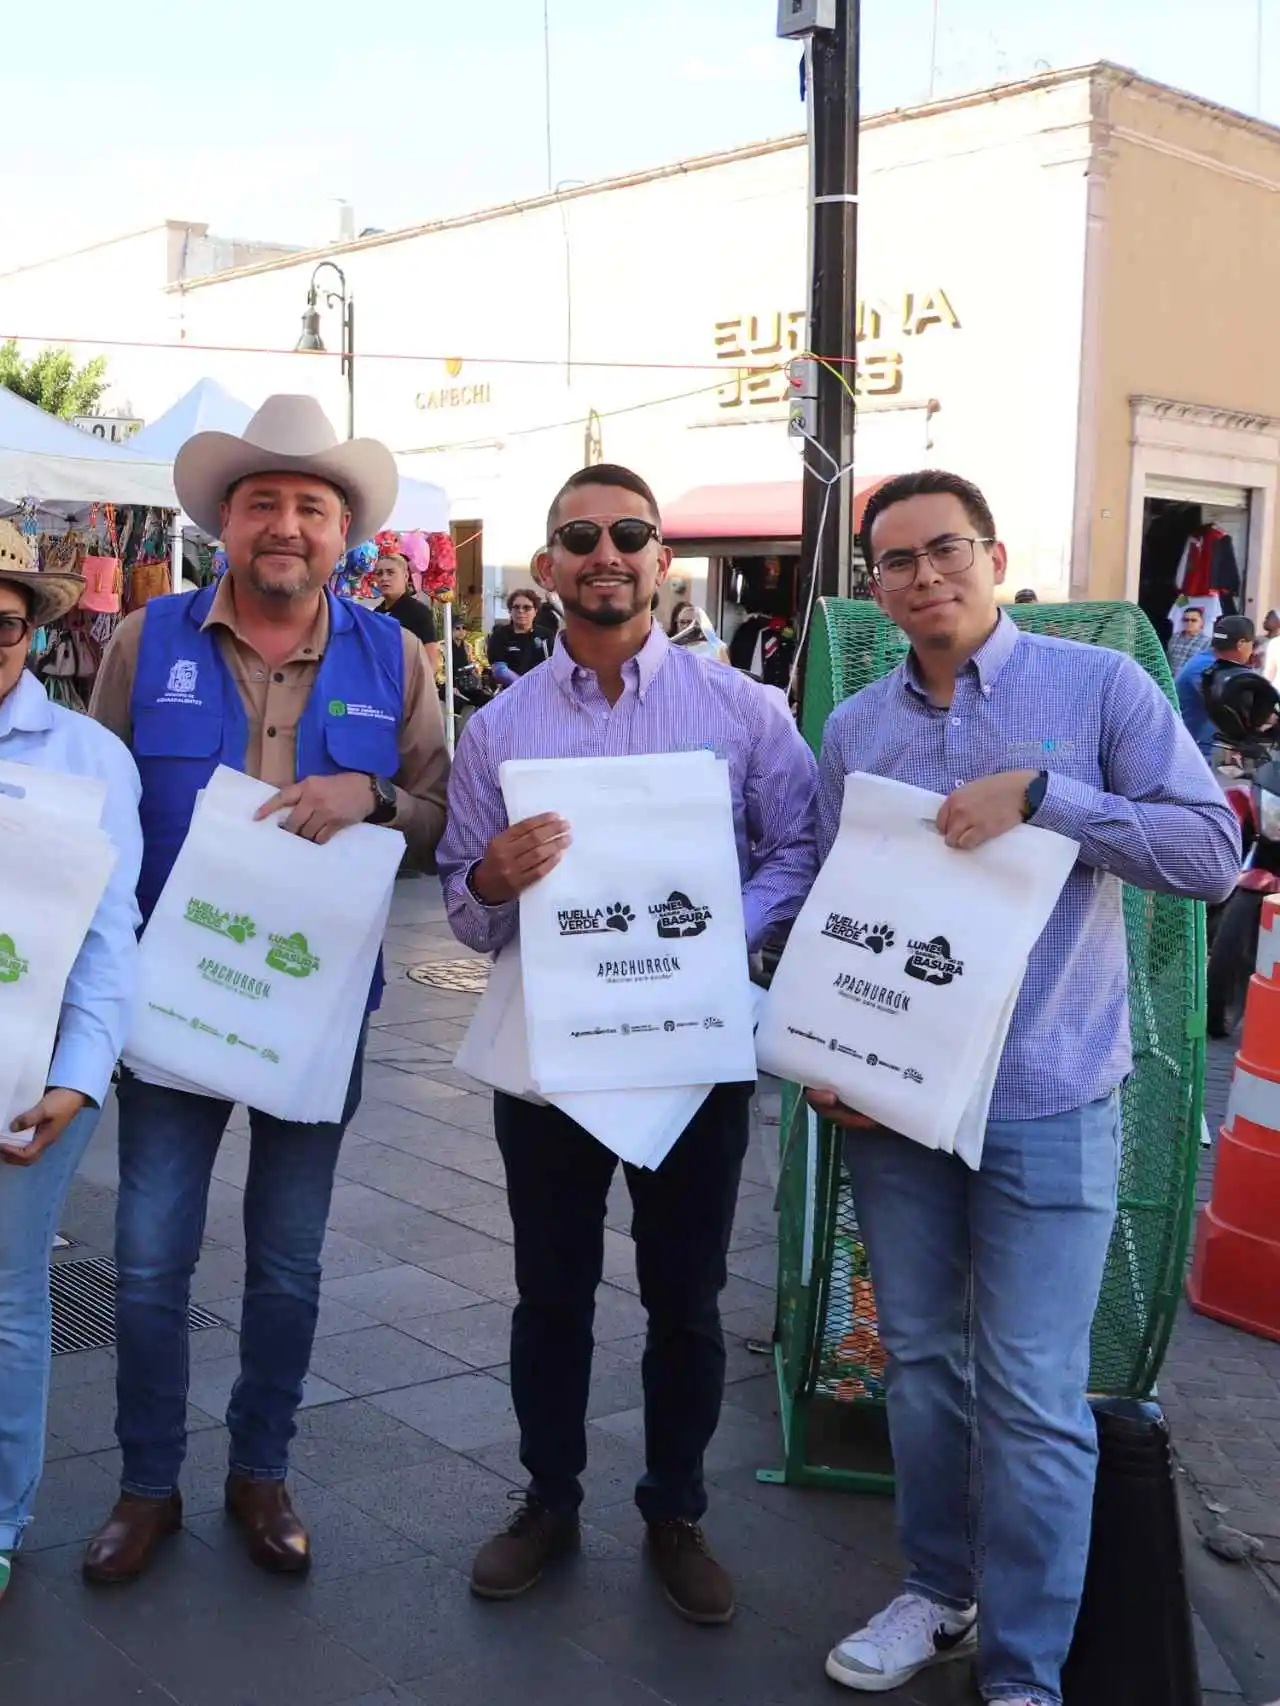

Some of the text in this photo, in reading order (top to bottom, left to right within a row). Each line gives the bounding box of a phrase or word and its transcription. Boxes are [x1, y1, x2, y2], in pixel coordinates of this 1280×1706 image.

[713, 287, 962, 360] EURNA
[712, 351, 904, 409] JES
[558, 908, 604, 920] HUELLA
[559, 918, 599, 931] VERDE
[662, 910, 712, 927] BASURA
[827, 912, 869, 934] HUELLA
[825, 921, 862, 941] VERDE
[597, 954, 681, 977] APACHURRÓN
[912, 955, 963, 976] BASURA
[833, 973, 911, 1011] APACHURRÓN
